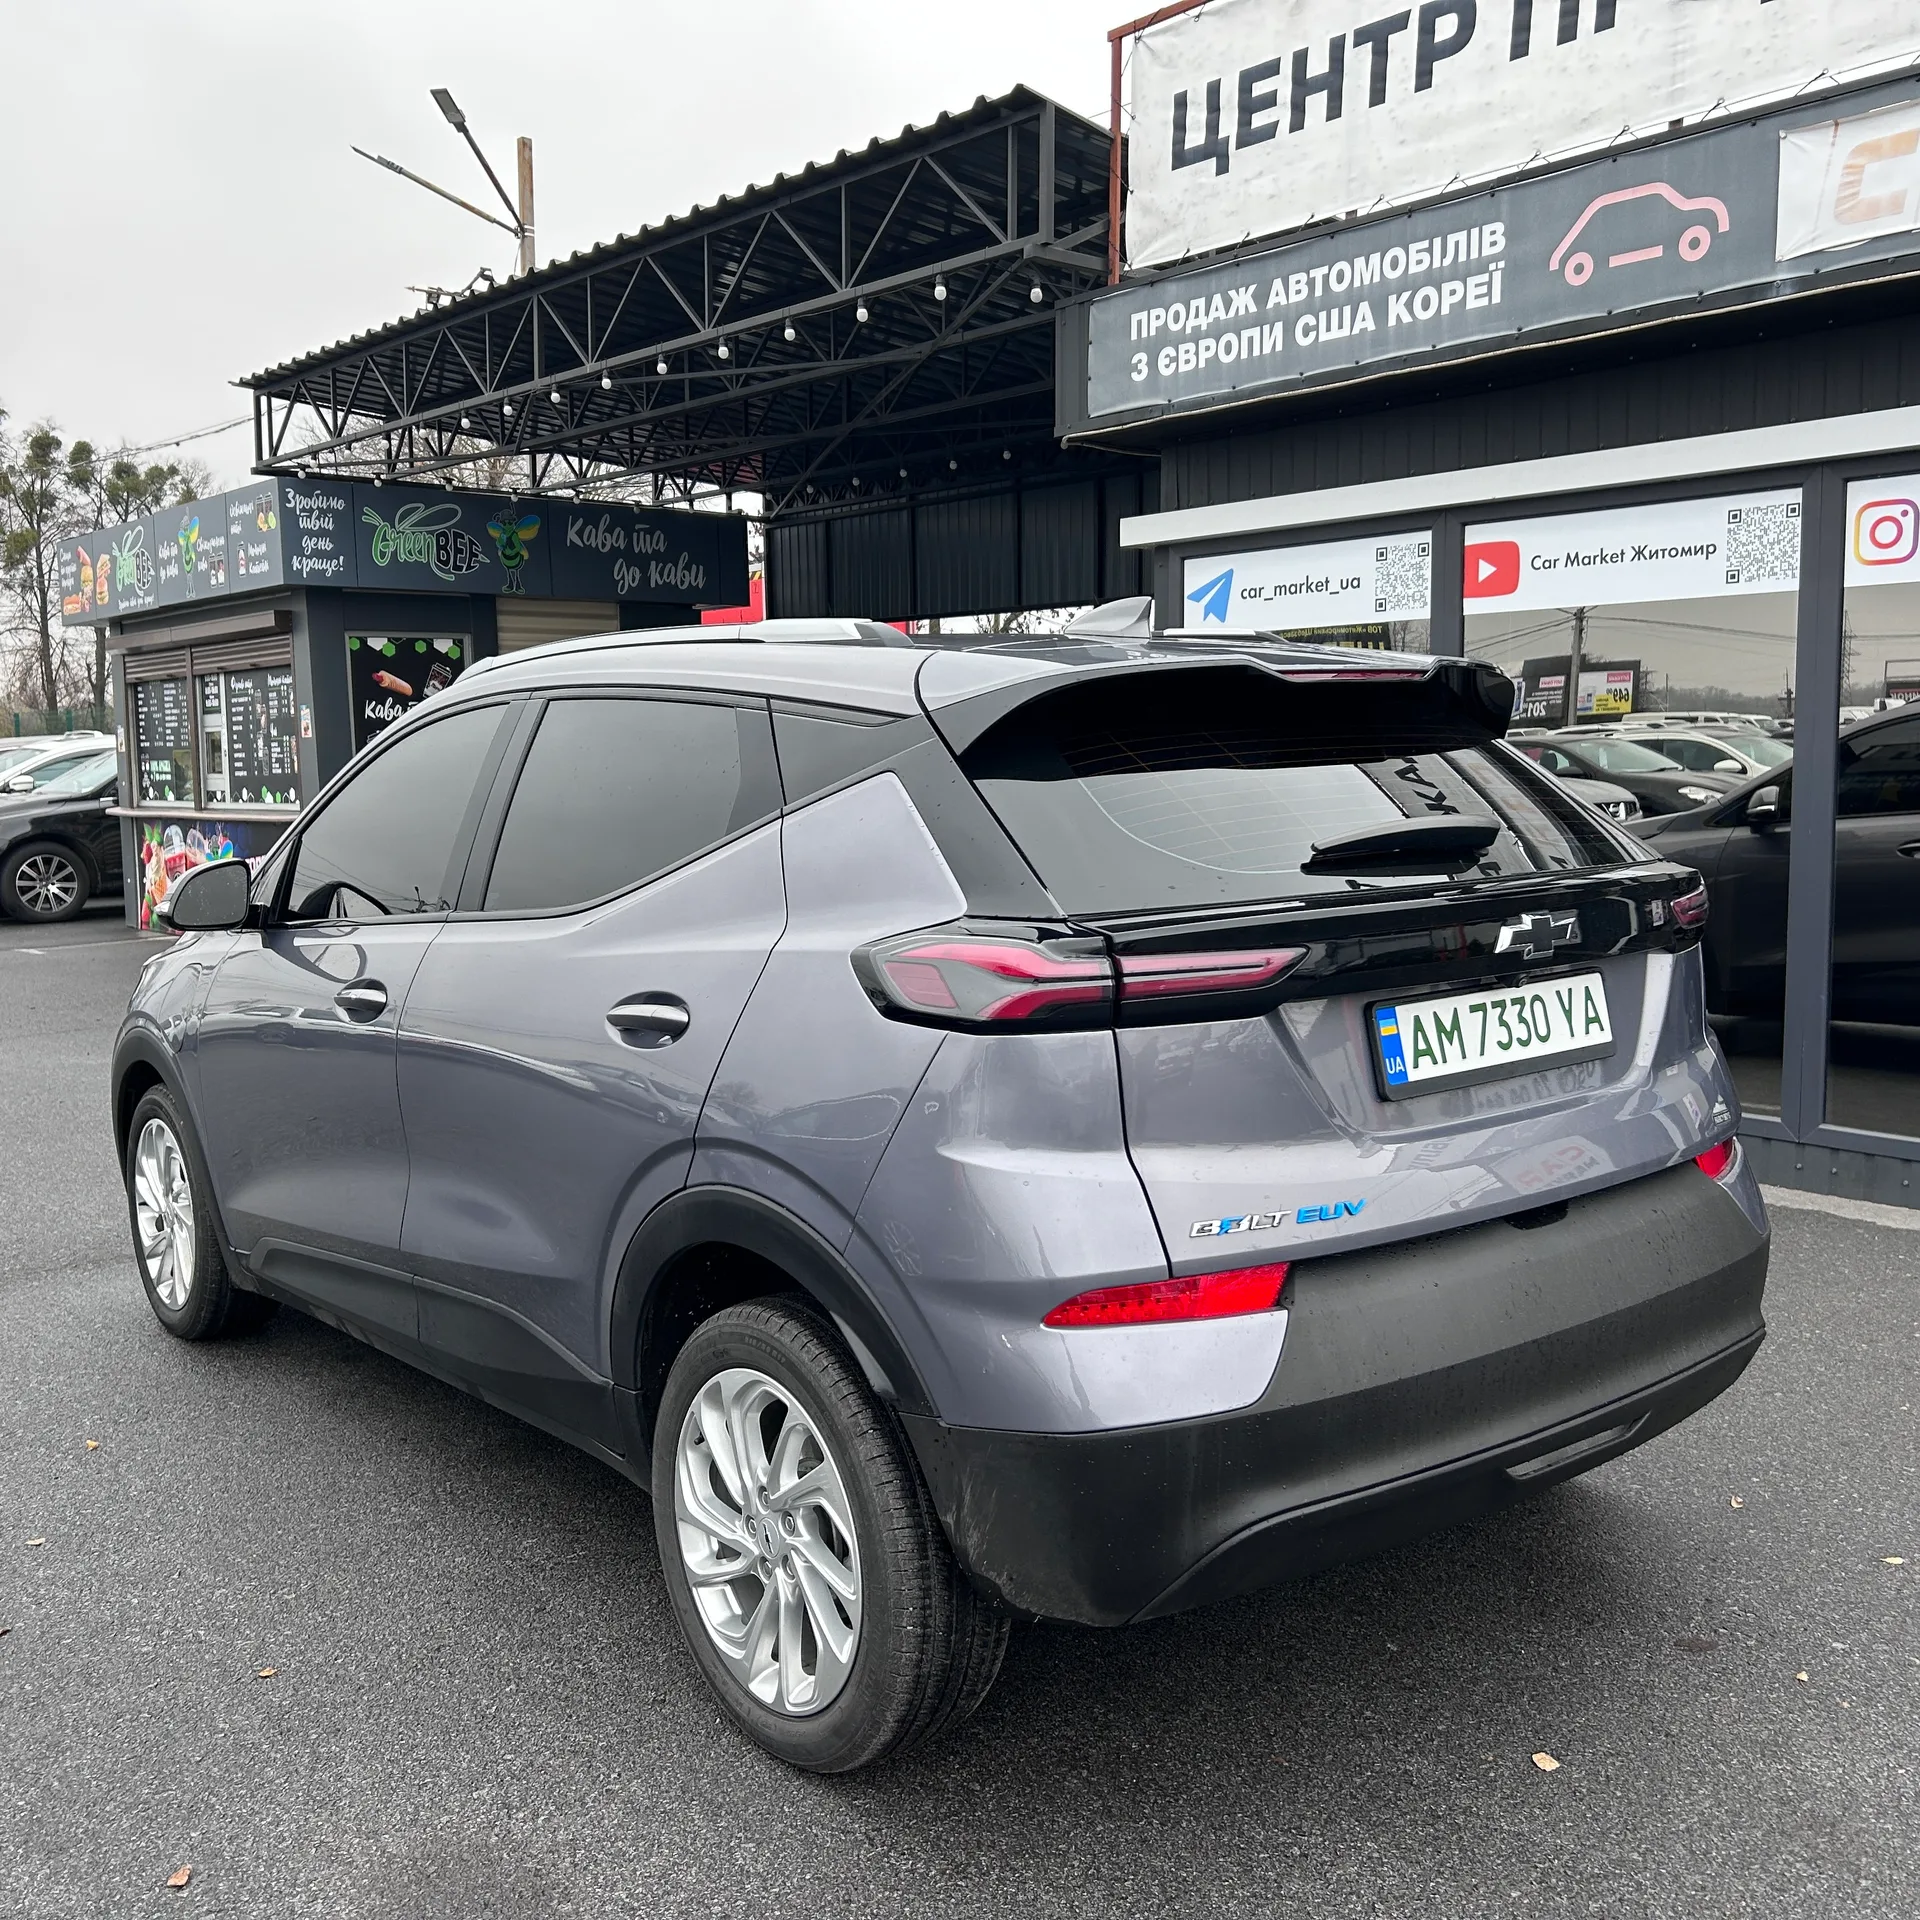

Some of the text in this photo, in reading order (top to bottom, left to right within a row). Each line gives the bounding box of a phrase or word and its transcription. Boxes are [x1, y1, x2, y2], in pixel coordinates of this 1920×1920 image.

[1172, 0, 1477, 175] ЦЕНТР
[1130, 222, 1506, 341] ПРОДАЖ АВТОМОБІЛІВ
[1158, 321, 1283, 376] ЄВРОПИ
[1295, 301, 1376, 347] США
[1388, 261, 1506, 327] КОРЕЇ
[285, 488, 346, 515] Зробимо
[299, 509, 334, 531] твій
[566, 513, 668, 554] Кава та
[302, 534, 334, 555] день
[1530, 543, 1718, 571] Car Market Житомир
[291, 555, 344, 578] краще!
[613, 552, 706, 595] до кави
[1240, 574, 1361, 602] car_market_ua
[364, 697, 405, 720] Кава
[1412, 985, 1605, 1069] AM 7330 YA
[1385, 1057, 1405, 1075] UA
[1189, 1198, 1367, 1238] BOLT EUV
